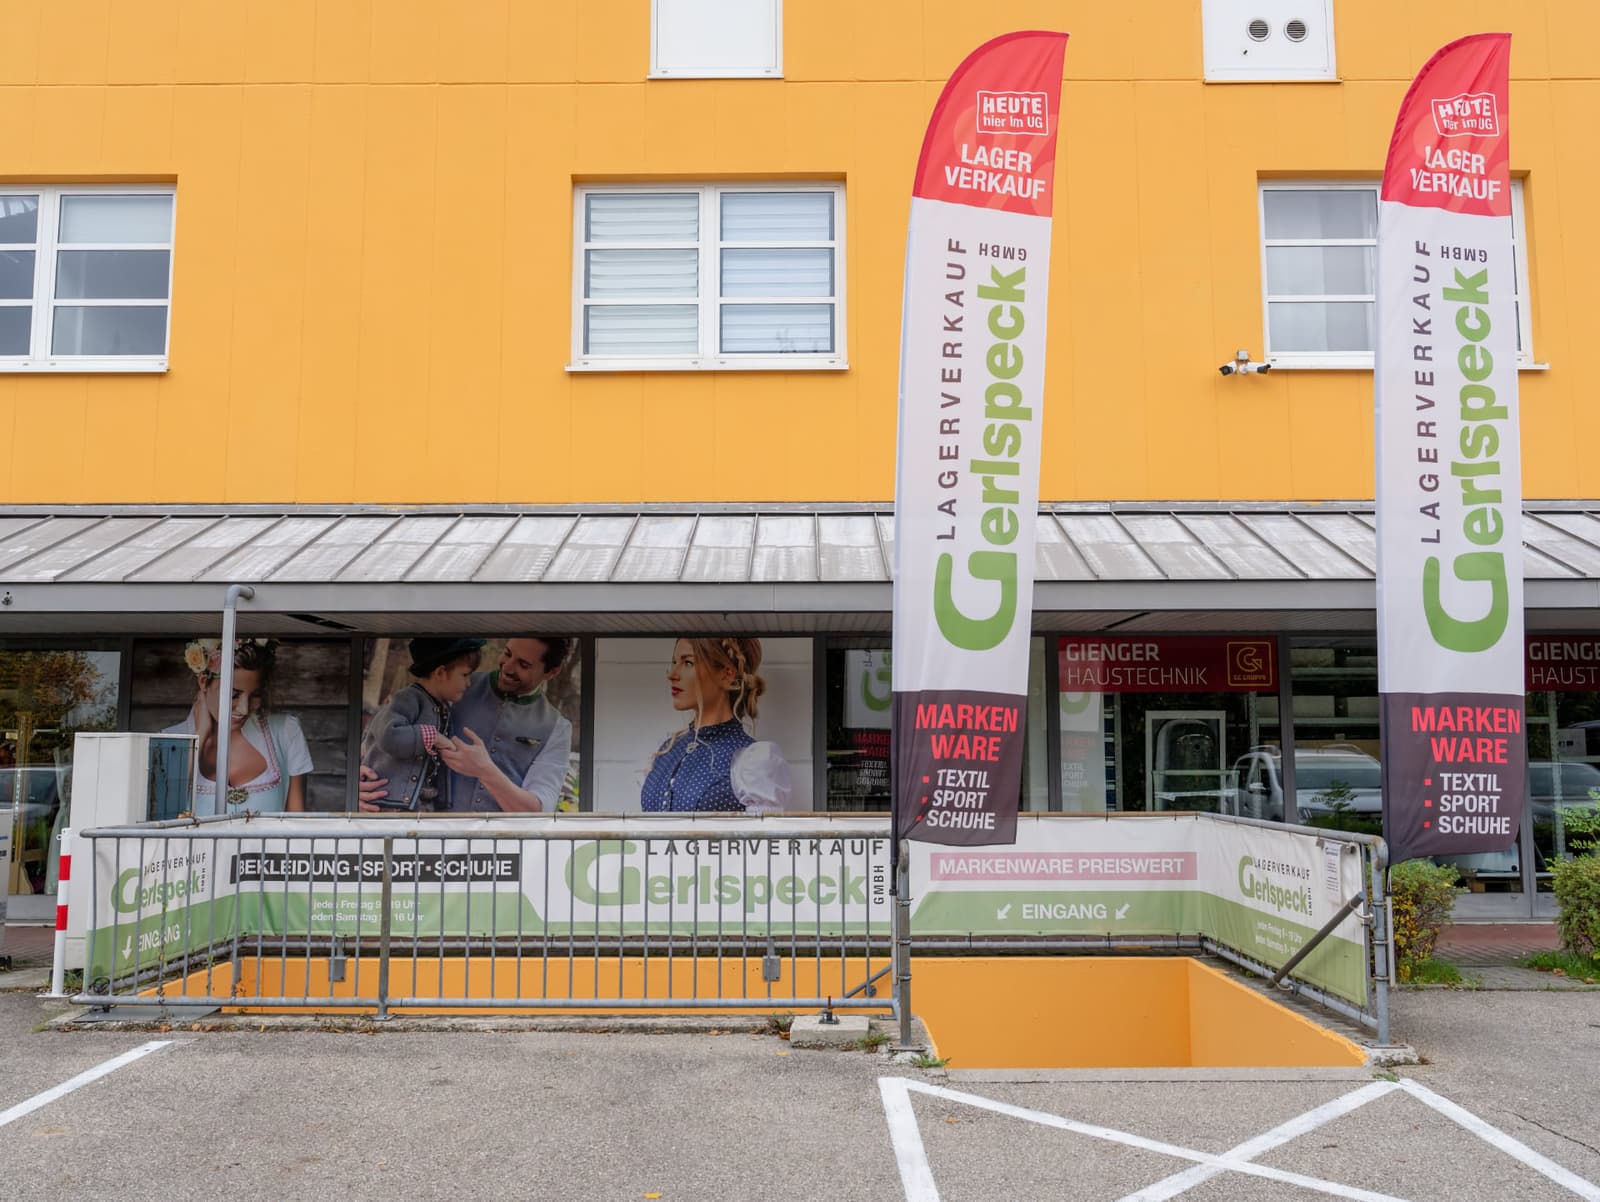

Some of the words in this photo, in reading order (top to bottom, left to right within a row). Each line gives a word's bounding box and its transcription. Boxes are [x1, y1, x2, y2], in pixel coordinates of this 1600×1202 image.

[983, 96, 1042, 114] HEUTE
[983, 115, 1006, 127] hier
[1027, 116, 1043, 128] UG
[1443, 119, 1459, 130] her
[1462, 118, 1477, 128] im
[1478, 117, 1493, 130] UG
[961, 143, 1032, 173] LAGER
[1424, 145, 1485, 175] LAGER
[944, 165, 1046, 200] VERKAUF
[1409, 167, 1501, 200] VERKAUF
[978, 242, 1028, 261] GMBH
[1440, 245, 1488, 263] GMBH
[936, 237, 967, 540] LAGERVERKAUF
[1413, 240, 1441, 544] LAGERVERKAUF
[934, 264, 1032, 651] Gerlspeck
[1422, 266, 1510, 653] Gerlspeck
[1066, 643, 1160, 661] GIENGER
[1067, 666, 1209, 686] HAUSTECHNIK
[1531, 666, 1599, 684] HAUST
[915, 703, 1018, 733] MARKEN
[1411, 706, 1521, 734] MARKEN
[930, 734, 1001, 762] WARE
[1430, 736, 1508, 764] WARE
[936, 769, 990, 789] TEXTIL
[1440, 772, 1502, 792] TEXTIL
[932, 789, 987, 809] SPORT
[1440, 794, 1500, 813] SPORT
[926, 809, 996, 830] SCHUHE
[1438, 815, 1511, 835] SCHUHE
[647, 839, 884, 856] LAGERVERKAUF
[239, 859, 350, 876] BEKLEIDUNG
[362, 860, 424, 877] SPORT
[434, 860, 513, 876] SCHUHE
[939, 858, 1073, 875] MARKENWARE
[1078, 857, 1185, 874] PREISWERT
[1253, 856, 1310, 880] LAGERVERKAUF
[565, 840, 867, 913] Gerlspeck
[873, 864, 885, 905] GMBH
[1239, 855, 1308, 915] Gerlspeck
[111, 867, 200, 914] Gerlspek
[311, 912, 334, 920] eden
[336, 912, 377, 923] Samtag
[1022, 903, 1108, 919] EINGANG
